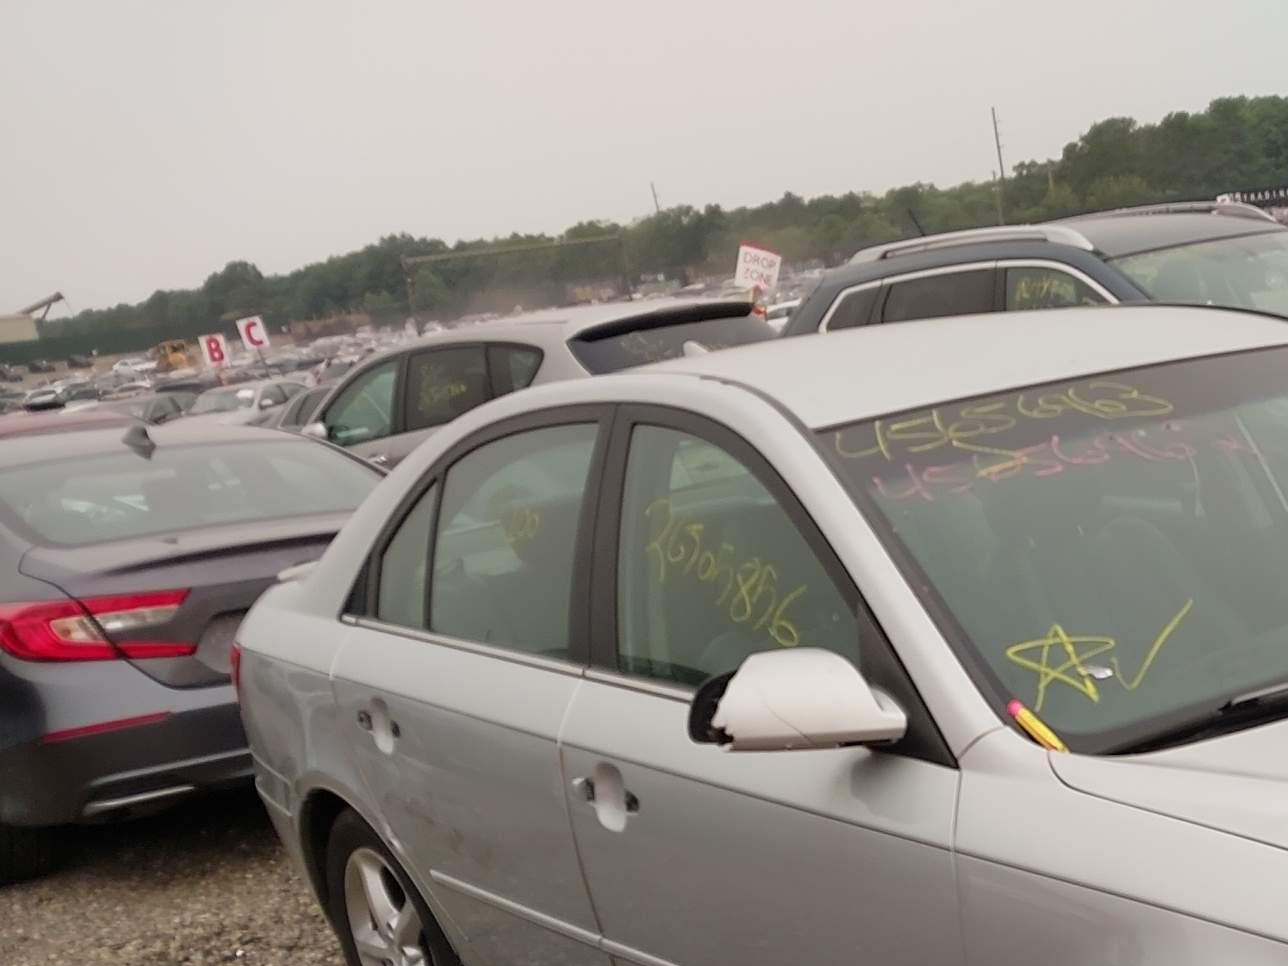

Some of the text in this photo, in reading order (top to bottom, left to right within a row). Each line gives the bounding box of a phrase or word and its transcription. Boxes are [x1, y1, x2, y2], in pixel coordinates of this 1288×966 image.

[743, 251, 776, 269] DROP
[245, 321, 264, 347] C
[206, 335, 224, 362] B
